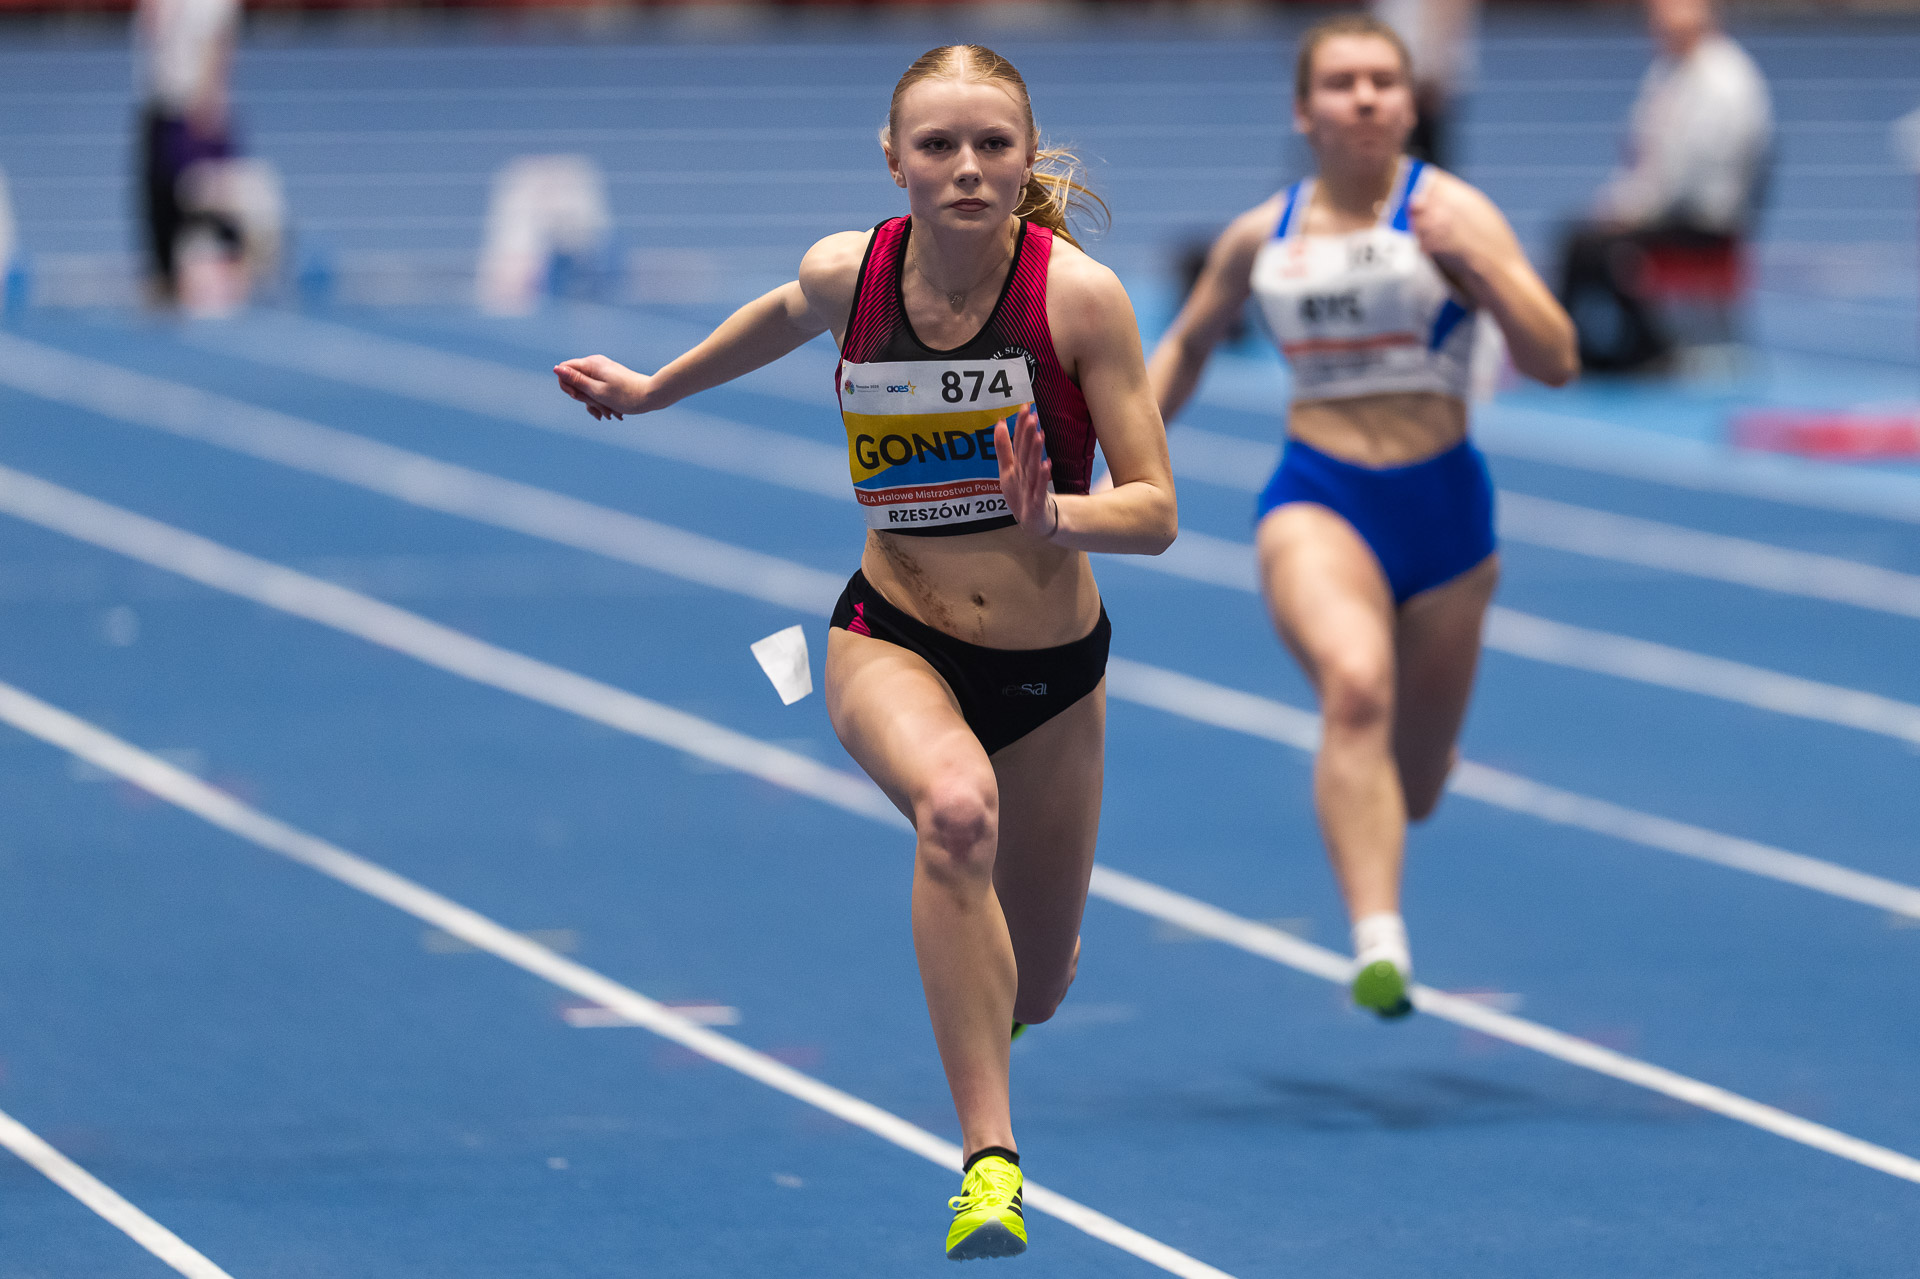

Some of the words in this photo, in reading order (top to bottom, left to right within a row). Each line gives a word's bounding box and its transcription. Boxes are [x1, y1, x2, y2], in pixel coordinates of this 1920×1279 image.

[941, 369, 1014, 404] 874
[855, 428, 998, 470] GONDE
[858, 493, 876, 503] PZLA
[878, 492, 914, 502] Halowe
[915, 485, 973, 499] Mistrzostwa
[888, 502, 971, 523] RZESZÓW
[975, 498, 1008, 514] 202
